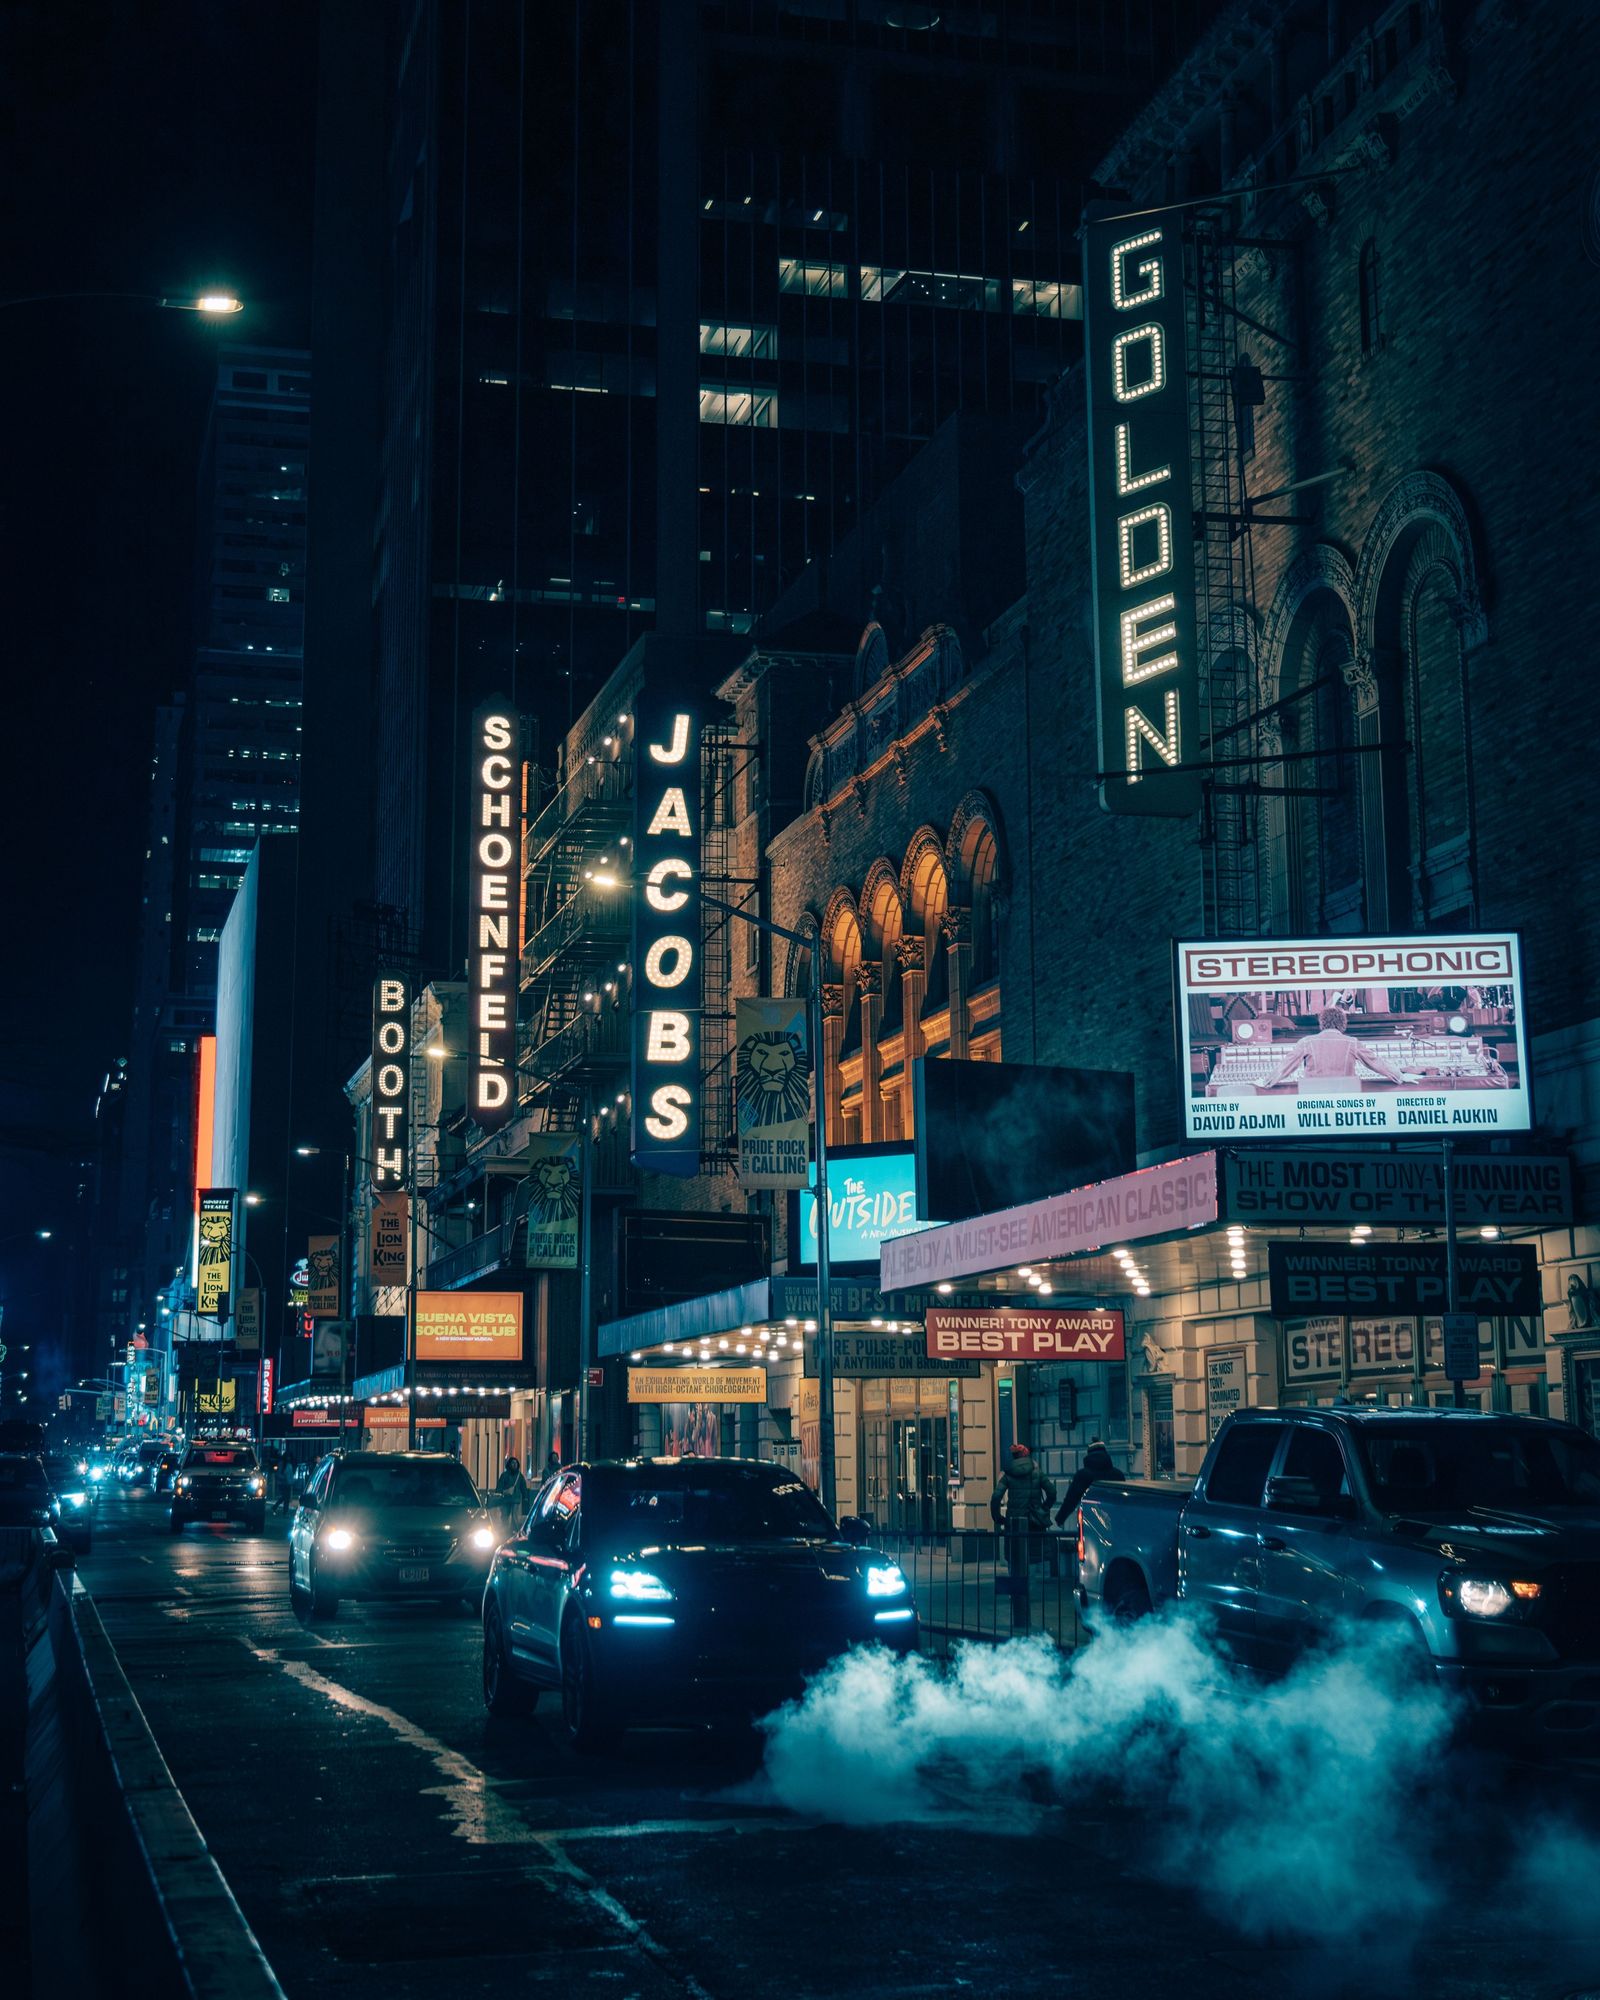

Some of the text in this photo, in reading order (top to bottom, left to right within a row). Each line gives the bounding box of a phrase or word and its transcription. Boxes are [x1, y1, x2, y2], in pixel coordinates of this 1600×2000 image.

[1111, 228, 1181, 784] GOLDEN
[477, 715, 512, 1108] SCHOENFELD
[645, 713, 694, 1141] JACOBS
[1197, 950, 1501, 978] STEREOPHONIC
[374, 980, 405, 1182] BOOTH
[1191, 1103, 1239, 1113] WRITTEN BY
[1297, 1099, 1376, 1110] ORIGINAL SONGS BY
[1397, 1097, 1447, 1107] DIRECTED BY
[1193, 1115, 1286, 1131] DAVID ADJMI
[1298, 1111, 1386, 1128] WILL BUTLER
[1398, 1109, 1498, 1126] DANIEL AUKIN
[742, 1139, 806, 1155] PRIDE ROCK
[752, 1156, 806, 1174] CALLING
[1236, 1161, 1275, 1187] THE
[1283, 1162, 1364, 1188] MOST
[844, 1178, 865, 1195] THE
[1237, 1191, 1341, 1211] SHOW
[1351, 1192, 1393, 1212] OF
[1474, 1194, 1564, 1214] YEAR
[809, 1187, 917, 1239] OUTSIDE
[381, 1218, 399, 1228] THE
[944, 1237, 952, 1265] A
[955, 1218, 1027, 1261] MUST-SEE
[1031, 1194, 1120, 1244] AMERICAN
[377, 1232, 402, 1247] LION
[530, 1232, 575, 1244] PRIDE ROCK
[861, 1230, 867, 1240] A
[373, 1249, 405, 1266] KING
[537, 1244, 575, 1257] CALLING
[1285, 1255, 1376, 1272] WINNER!
[1382, 1256, 1440, 1272] TONY
[204, 1283, 223, 1294] LION
[1287, 1275, 1405, 1303] BEST
[201, 1296, 218, 1308] KIN
[785, 1296, 843, 1312] WINNR!
[847, 1287, 896, 1312] BEST
[416, 1312, 516, 1324] BUENA VISTA
[935, 1317, 1113, 1331] WINNER! TONY AWARD
[416, 1325, 517, 1336] SOCIAL CLUB
[937, 1331, 1114, 1353] BEST PLAY
[844, 1357, 895, 1369] ANYTHING
[899, 1357, 913, 1369] ON
[1219, 1362, 1233, 1375] MOST
[645, 1376, 690, 1385] EXHILARATING
[692, 1377, 714, 1385] WORLD
[716, 1377, 724, 1385] OF
[726, 1377, 760, 1385] MOVEMENT
[635, 1385, 653, 1394] WITH
[655, 1385, 703, 1394] HIGH-OCTANE
